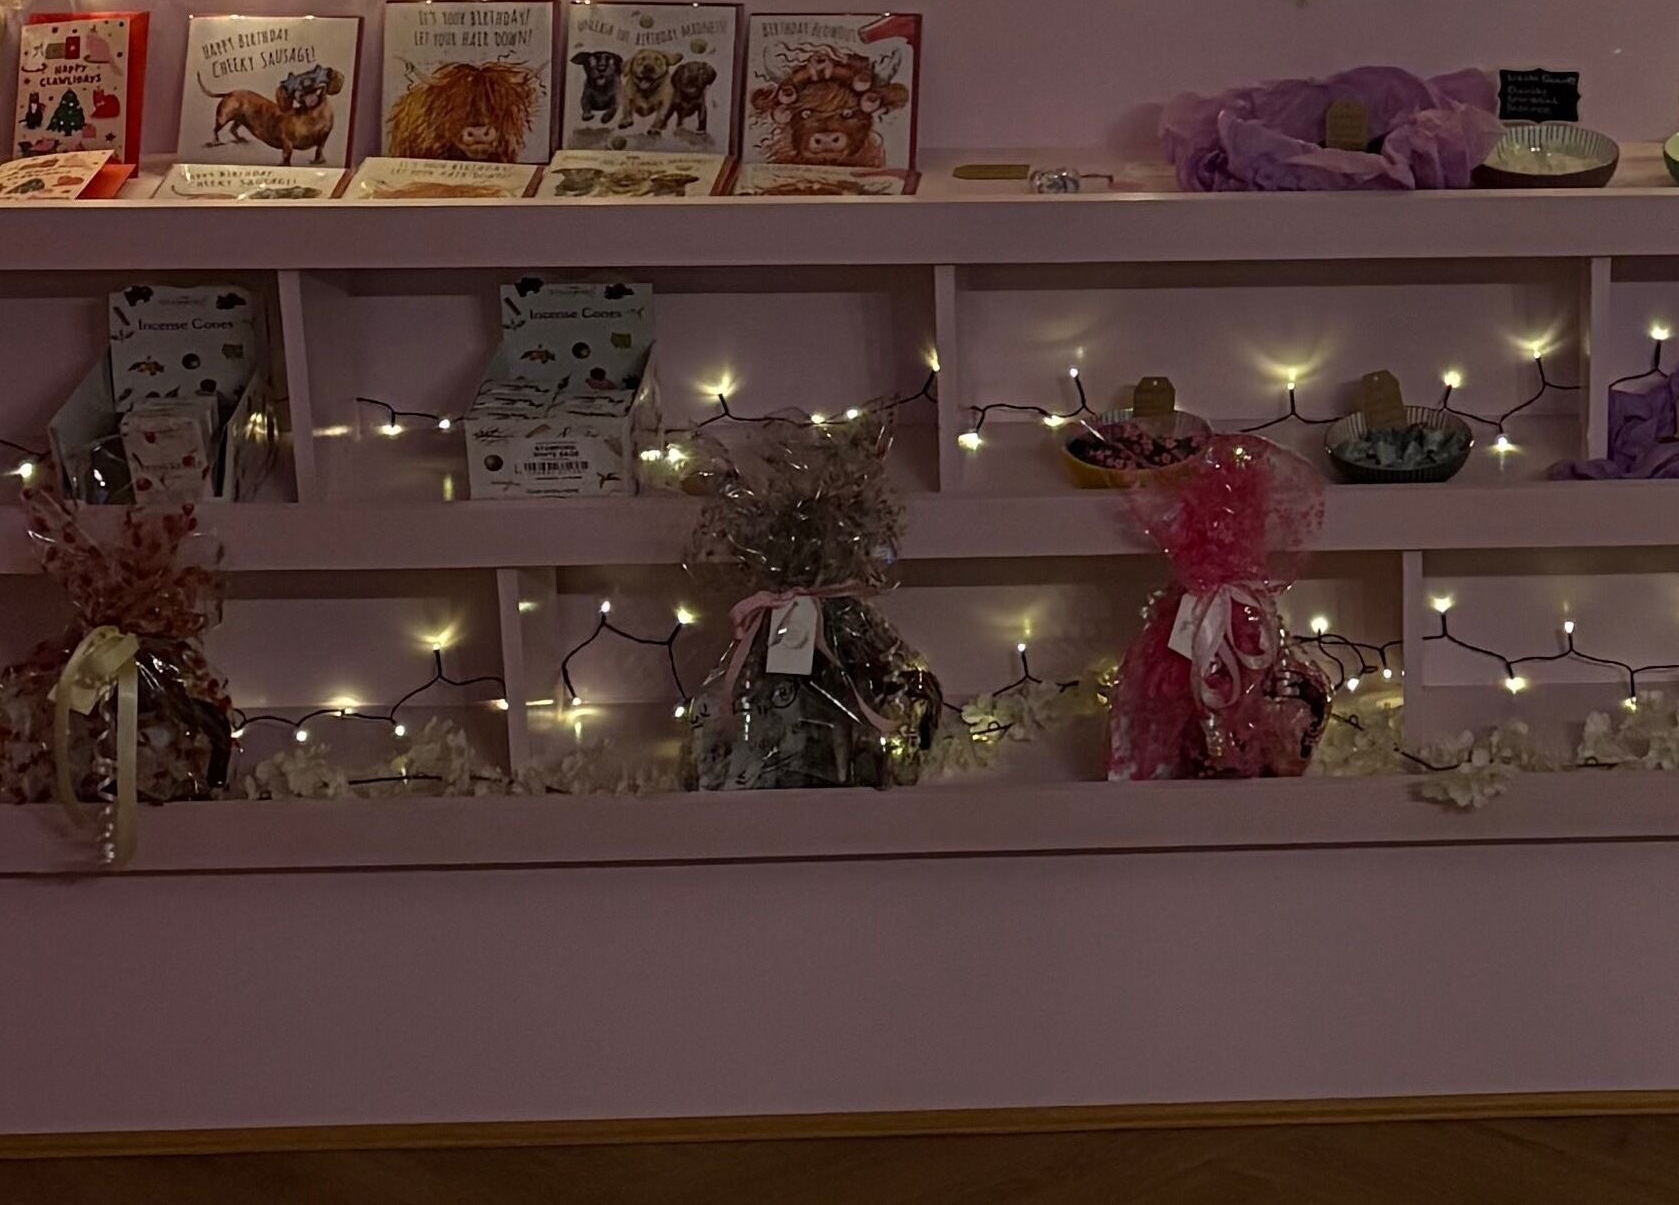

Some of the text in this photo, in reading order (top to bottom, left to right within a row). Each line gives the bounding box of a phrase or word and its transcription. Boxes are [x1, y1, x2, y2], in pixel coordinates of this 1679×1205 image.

[418, 7, 531, 26] IT'S YOUR BIRTHDAY!
[414, 29, 532, 47] LET YOUR HAIR DOWN!
[635, 28, 679, 46] BIRTHDAY
[761, 21, 808, 37] BIRTHDAY
[202, 29, 289, 61] HAPPY BIRTHDAY
[55, 63, 88, 74] HAPPY
[212, 46, 316, 78] CHEEKY SAUSAGE!
[530, 308, 622, 319] Incense Cones
[138, 319, 233, 331] Incense Cones
